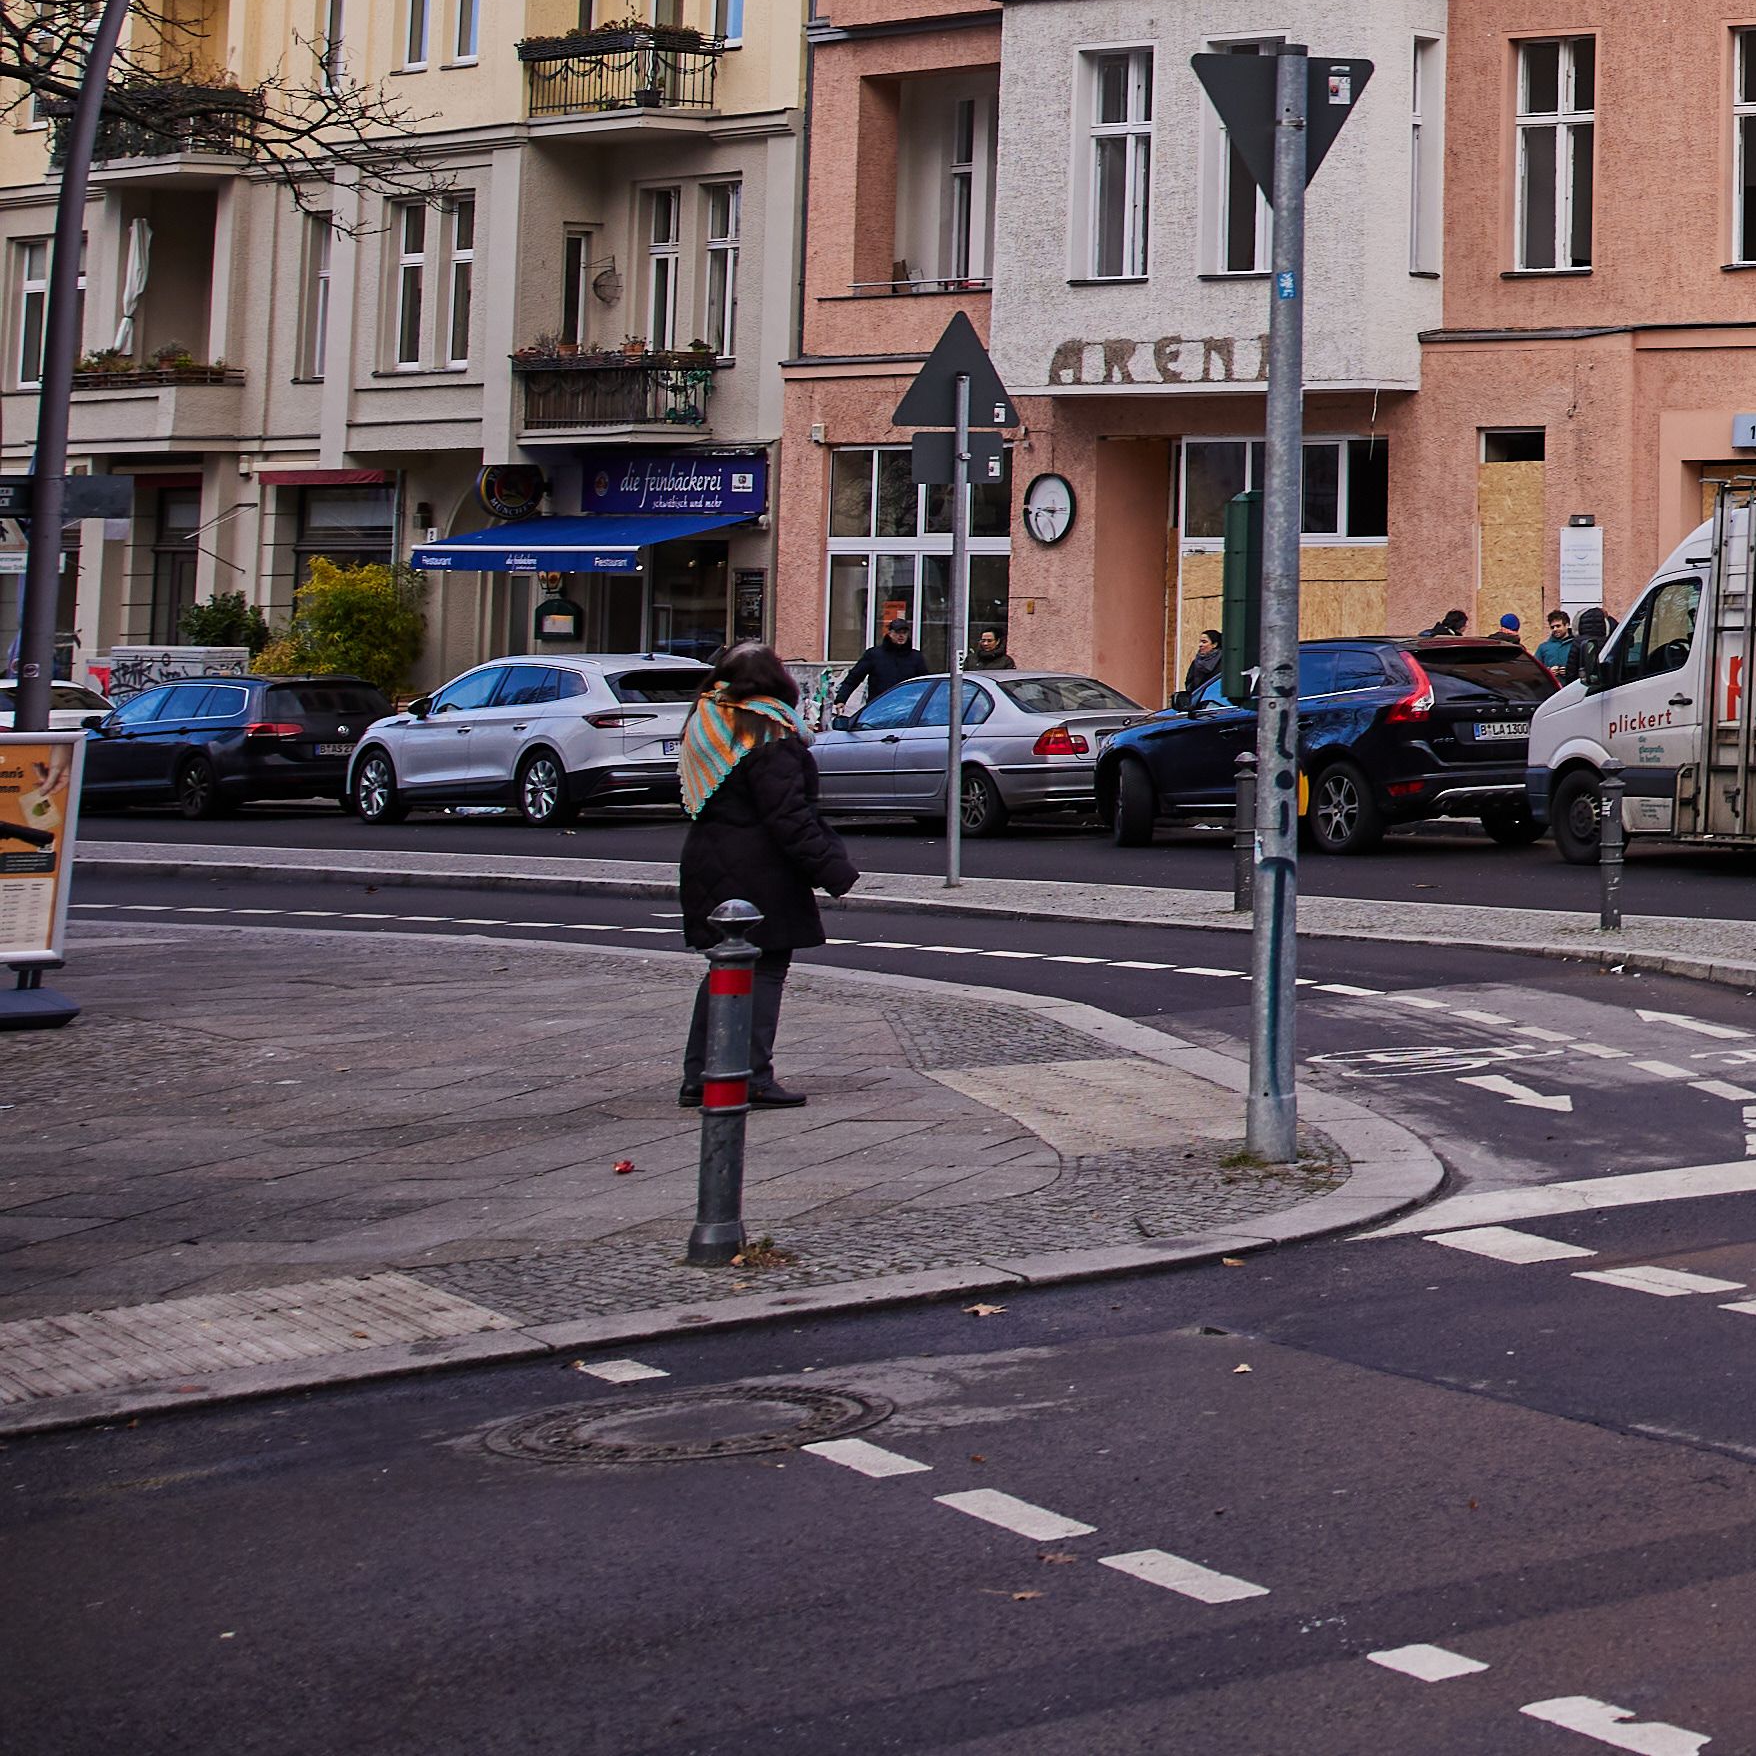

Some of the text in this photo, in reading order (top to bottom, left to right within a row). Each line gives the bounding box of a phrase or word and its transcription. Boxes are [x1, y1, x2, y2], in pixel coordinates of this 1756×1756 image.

[1750, 425, 1756, 440] 1
[638, 460, 722, 508] feinbäckerei
[705, 494, 723, 508] mehr
[421, 555, 452, 566] Restaurant
[594, 556, 627, 567] Restaurant
[1508, 724, 1528, 735] 1300
[1609, 709, 1672, 739] plickert
